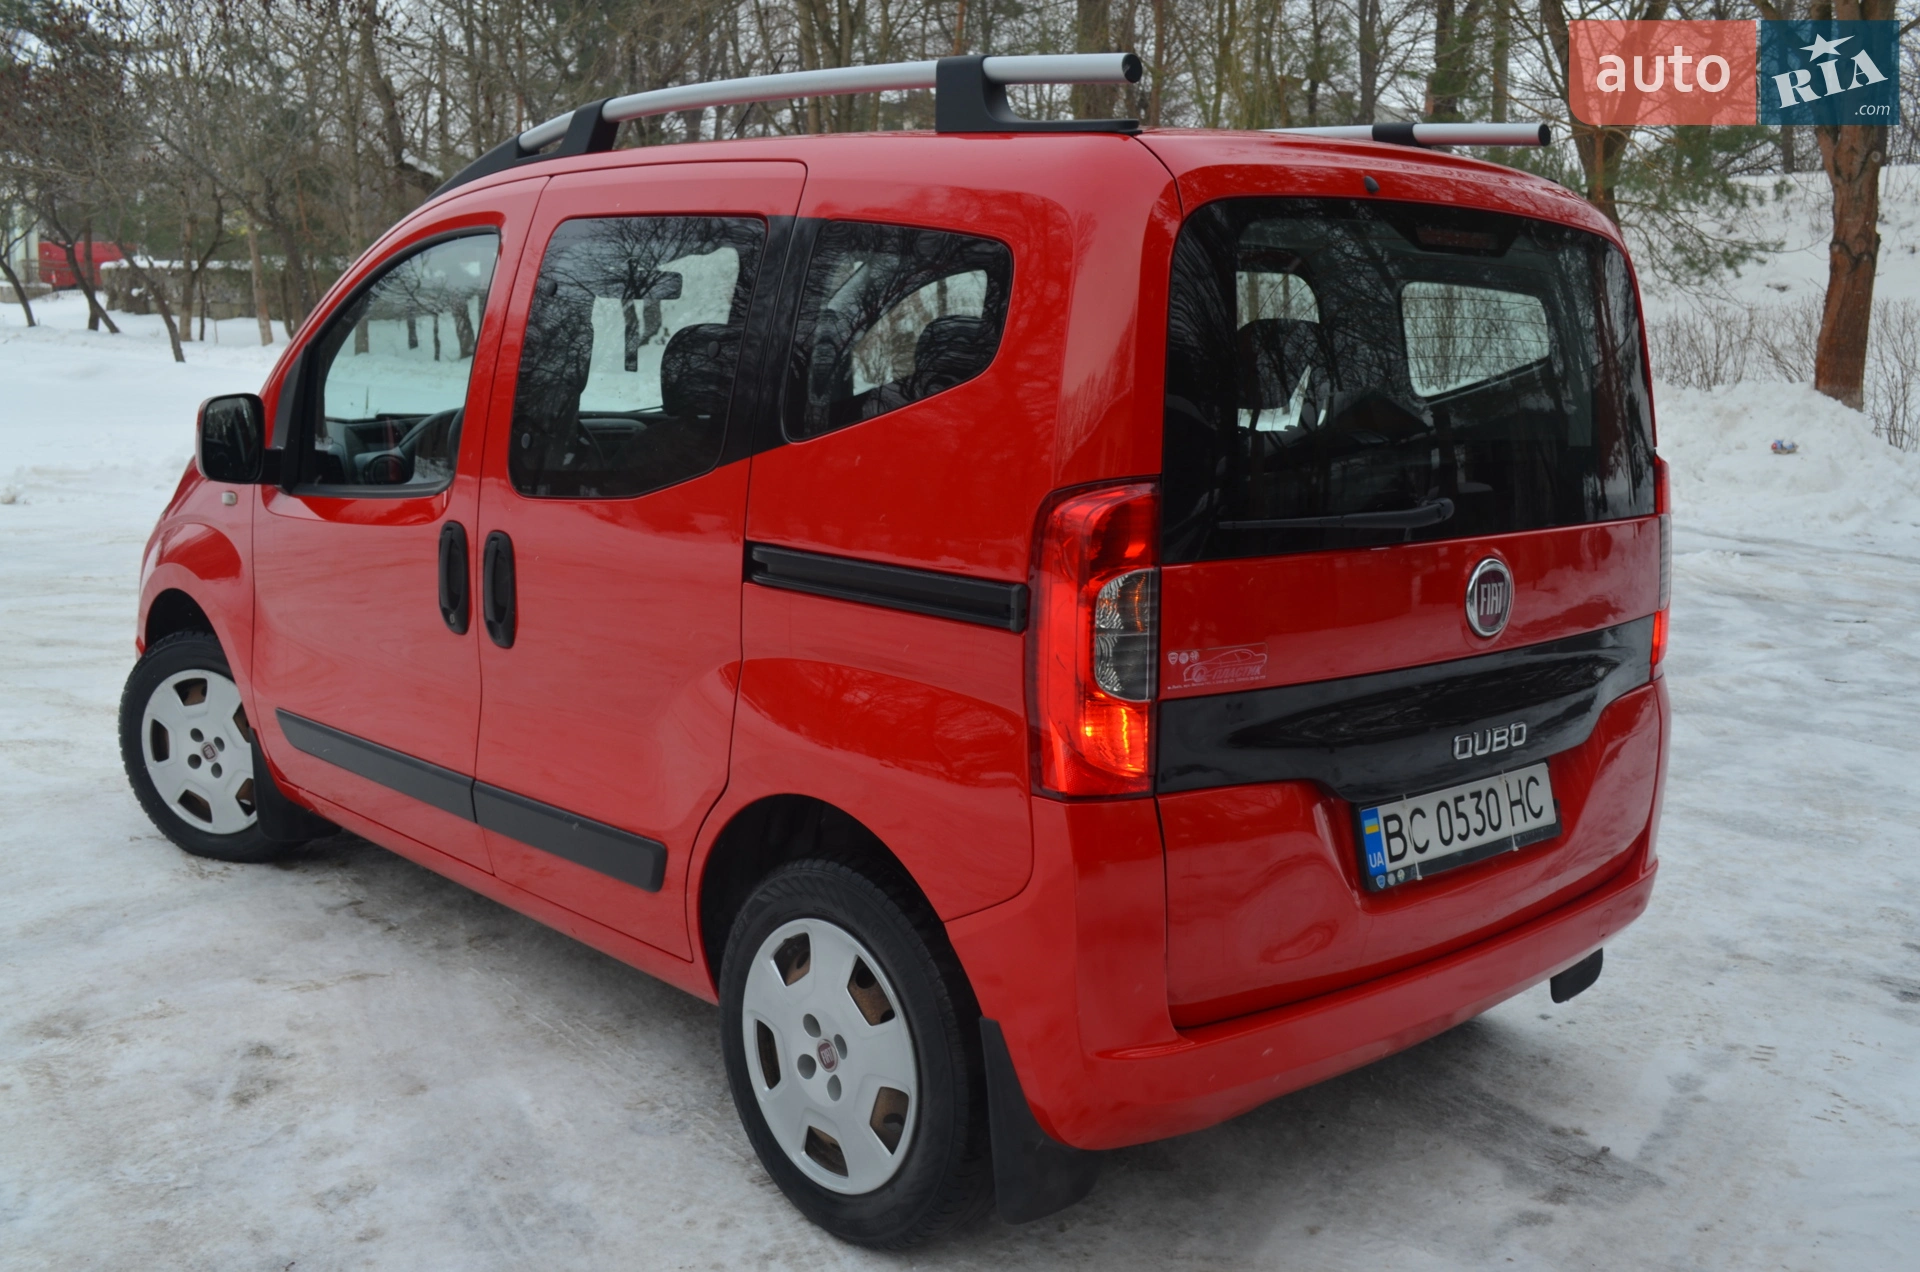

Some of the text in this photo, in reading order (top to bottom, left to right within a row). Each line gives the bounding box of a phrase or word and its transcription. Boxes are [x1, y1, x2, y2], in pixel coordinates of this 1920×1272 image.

[1480, 582, 1505, 616] FIAT
[1453, 721, 1527, 760] QUBO
[1383, 776, 1544, 863] BC 0530 HC
[1369, 852, 1385, 868] UA
